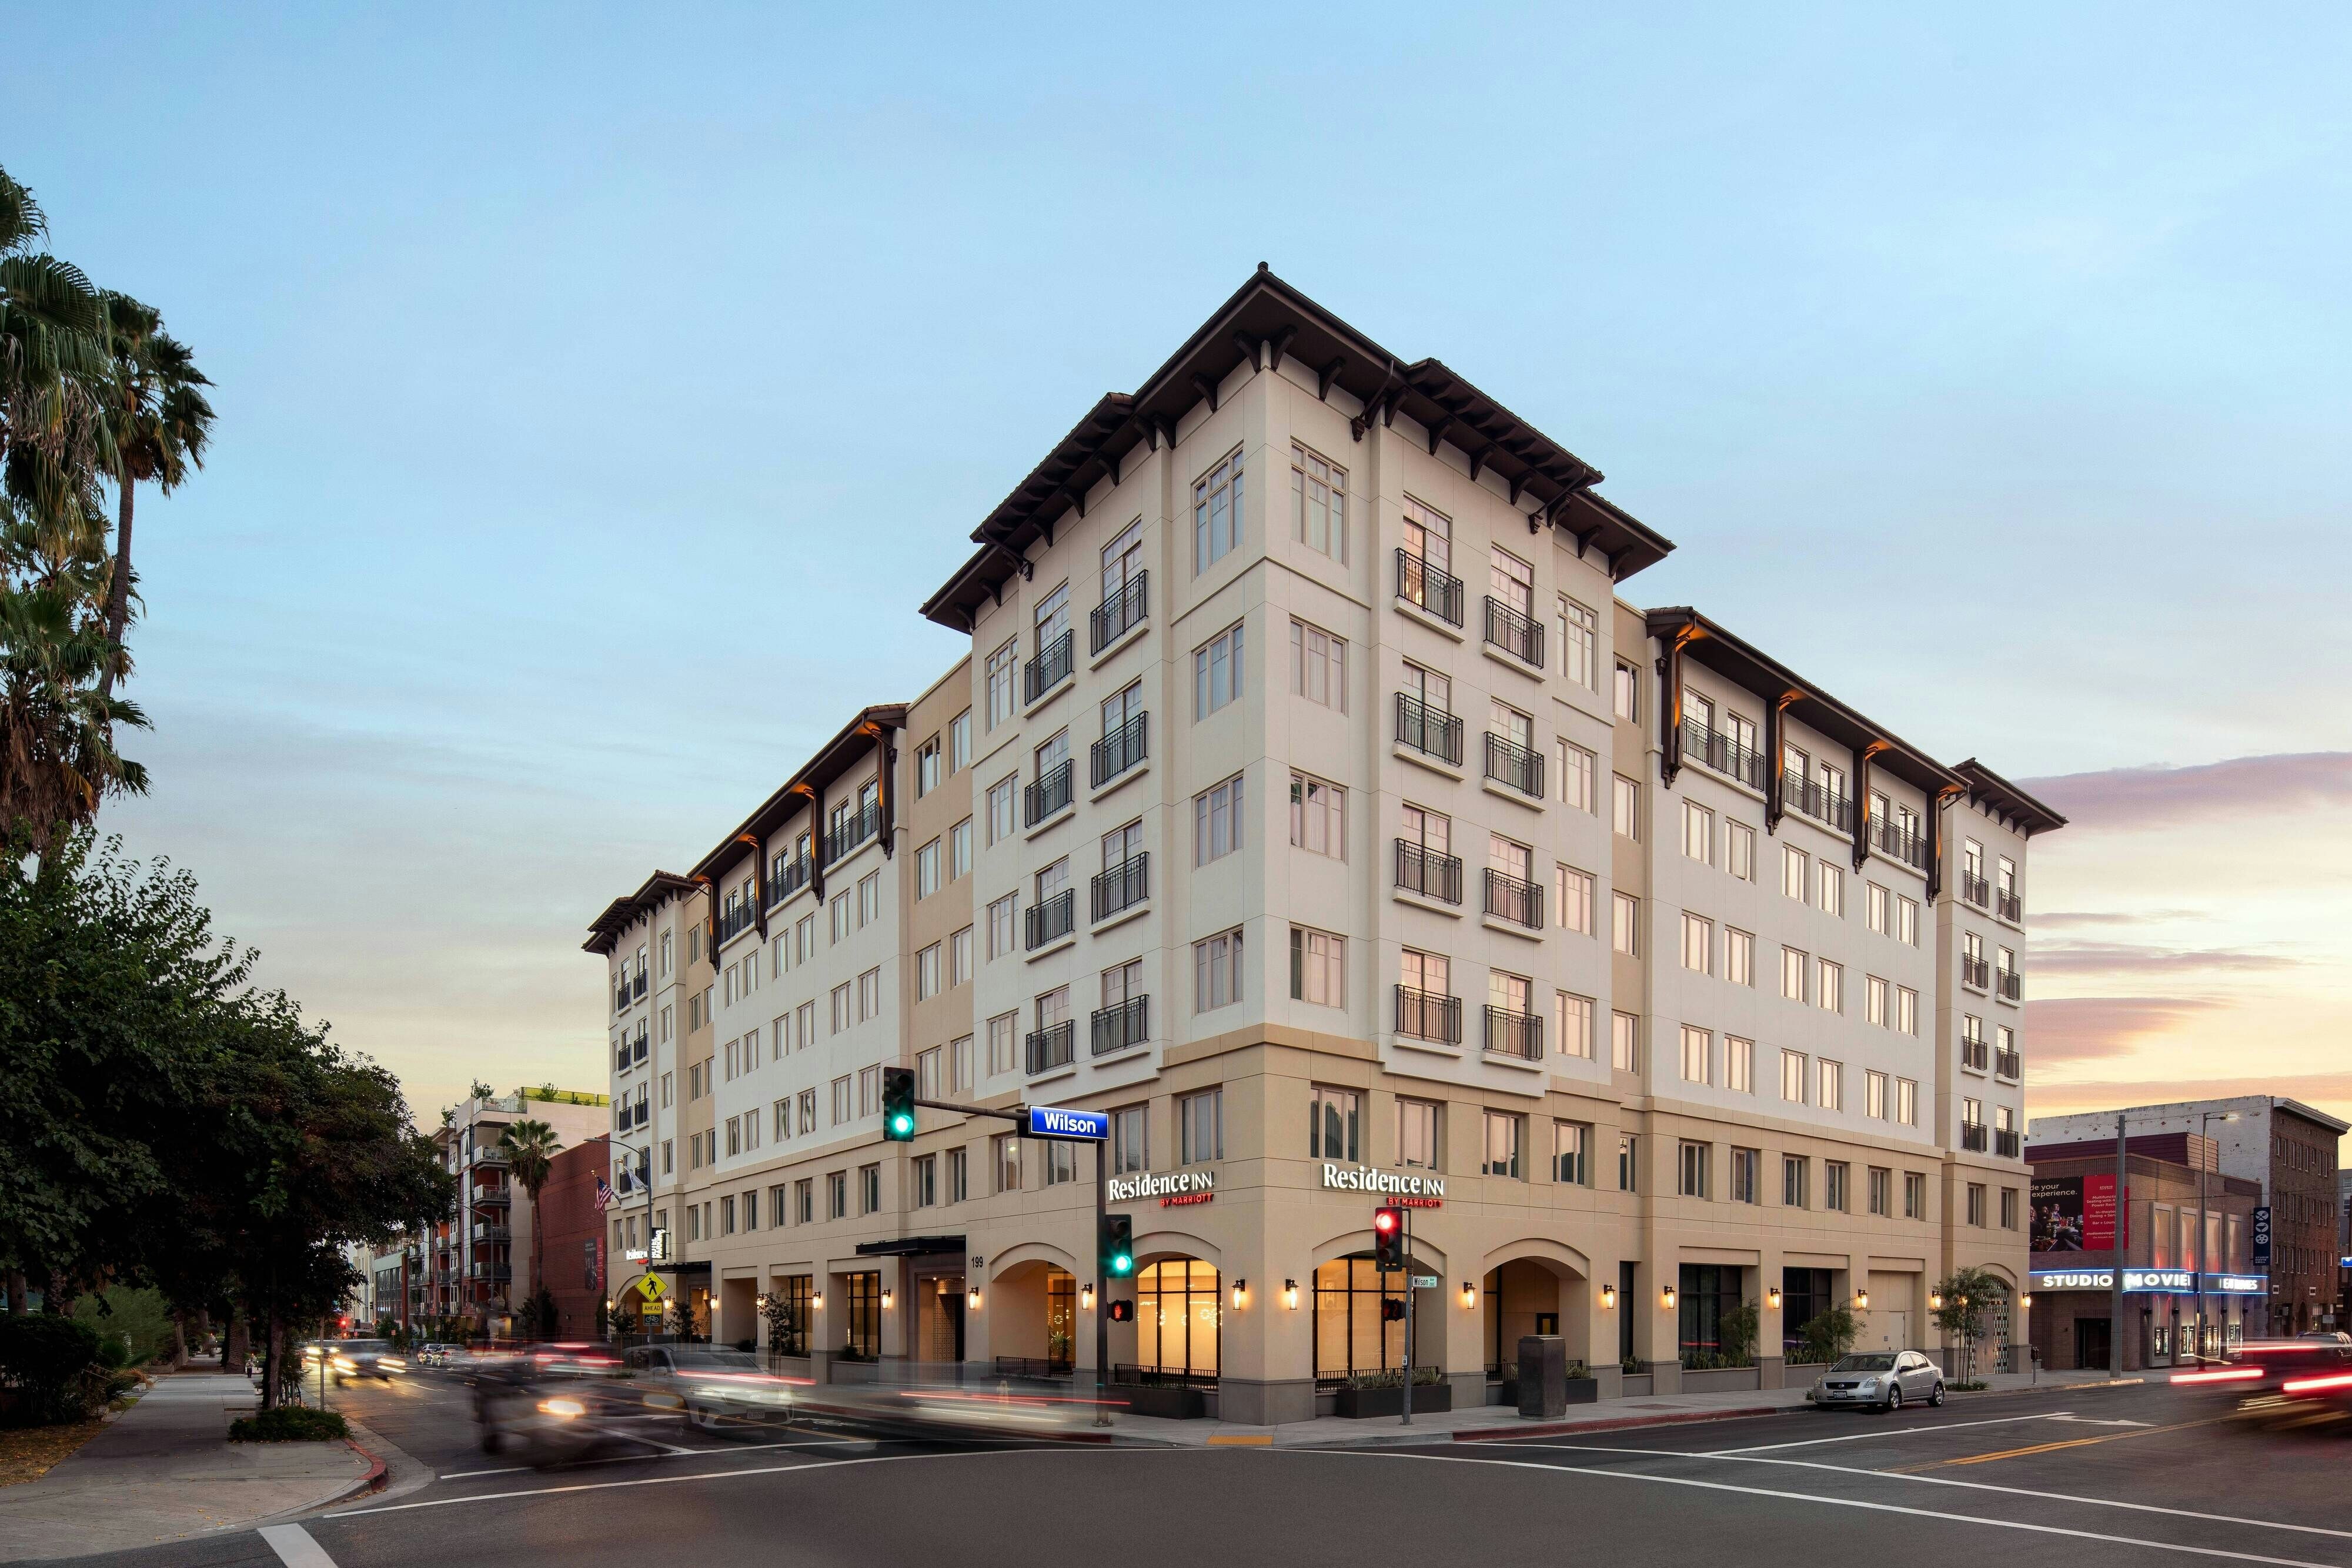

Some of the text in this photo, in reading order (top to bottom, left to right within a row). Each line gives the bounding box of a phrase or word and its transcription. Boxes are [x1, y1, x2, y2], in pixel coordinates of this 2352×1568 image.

[1044, 1112, 1096, 1134] Wilson
[1109, 1171, 1214, 1201] Residence INN
[1323, 1164, 1444, 1196] Residence INN
[2032, 1189, 2077, 1198] experience.
[2041, 1184, 2059, 1192] your
[1160, 1193, 1213, 1206] BY MARRIOTT
[1388, 1197, 1443, 1208] BY MARRIOTT
[971, 1256, 983, 1268] 199
[1414, 1277, 1429, 1286] Wilson
[2043, 1273, 2113, 1287] STUDIO
